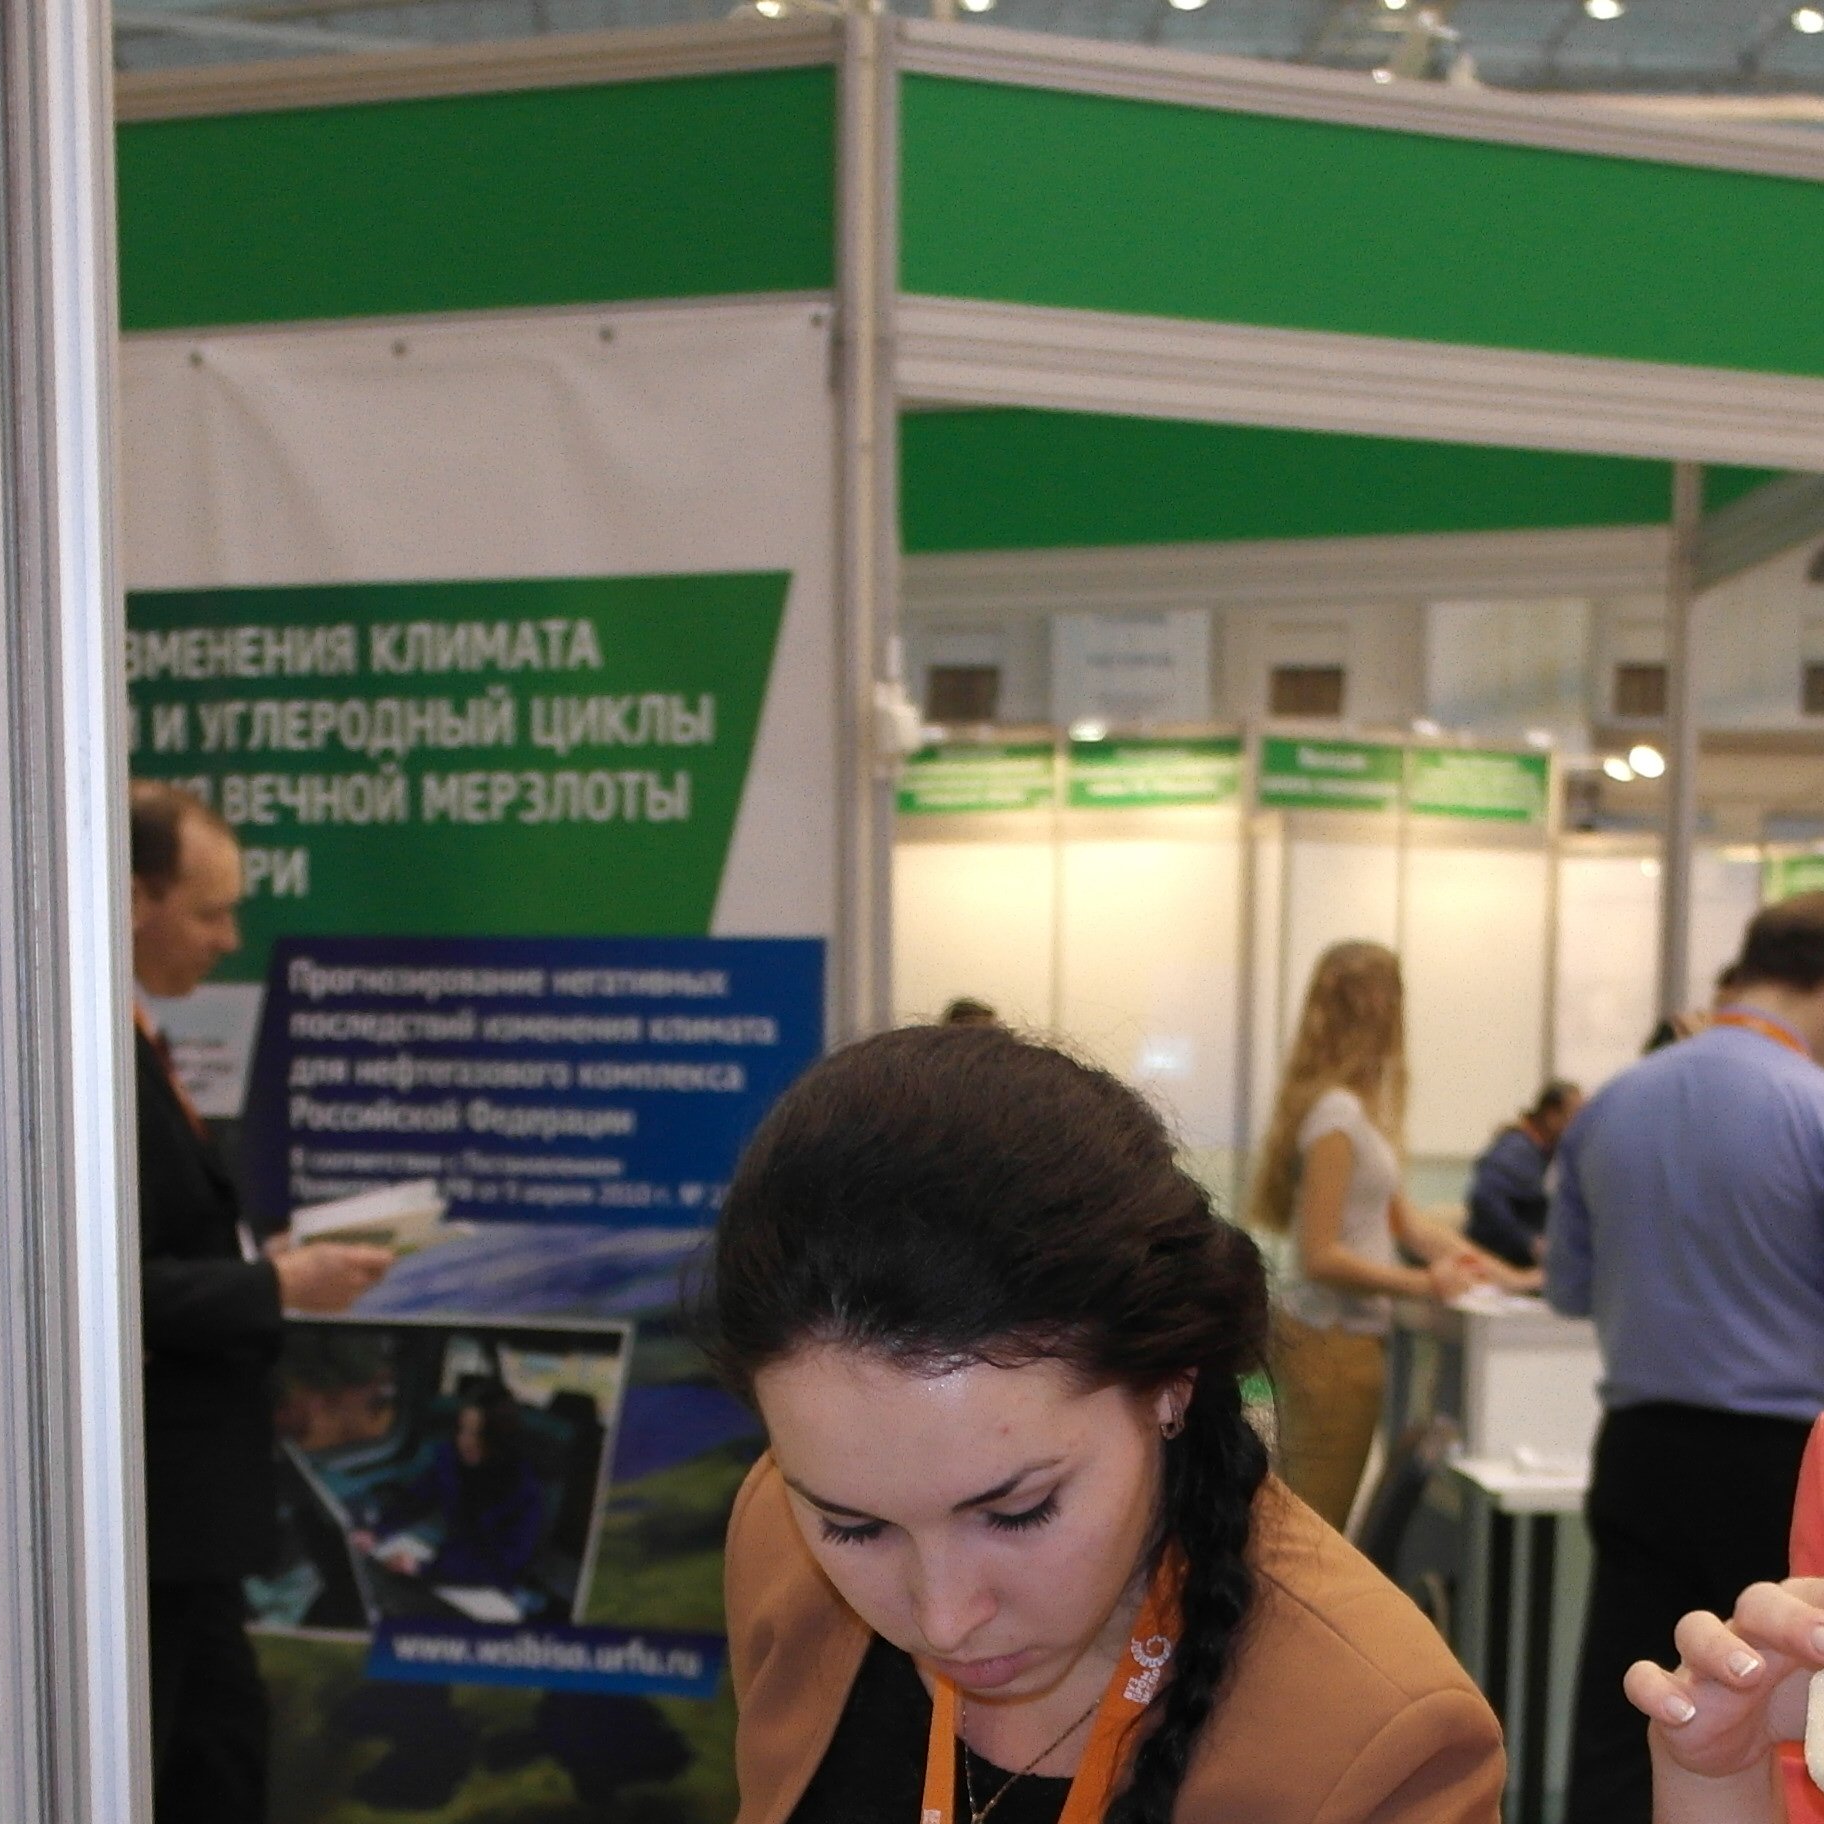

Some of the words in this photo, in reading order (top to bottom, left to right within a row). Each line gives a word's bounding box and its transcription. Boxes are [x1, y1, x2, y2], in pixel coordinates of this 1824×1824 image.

[371, 620, 602, 673] КЛИМАТА
[196, 685, 516, 757] УГЛЕРОДНЫЙ
[531, 692, 717, 754] ЦИКЛЫ
[222, 763, 408, 826] ВЕЧНОЙ
[423, 771, 692, 824] МЕРЗЛОТЫ
